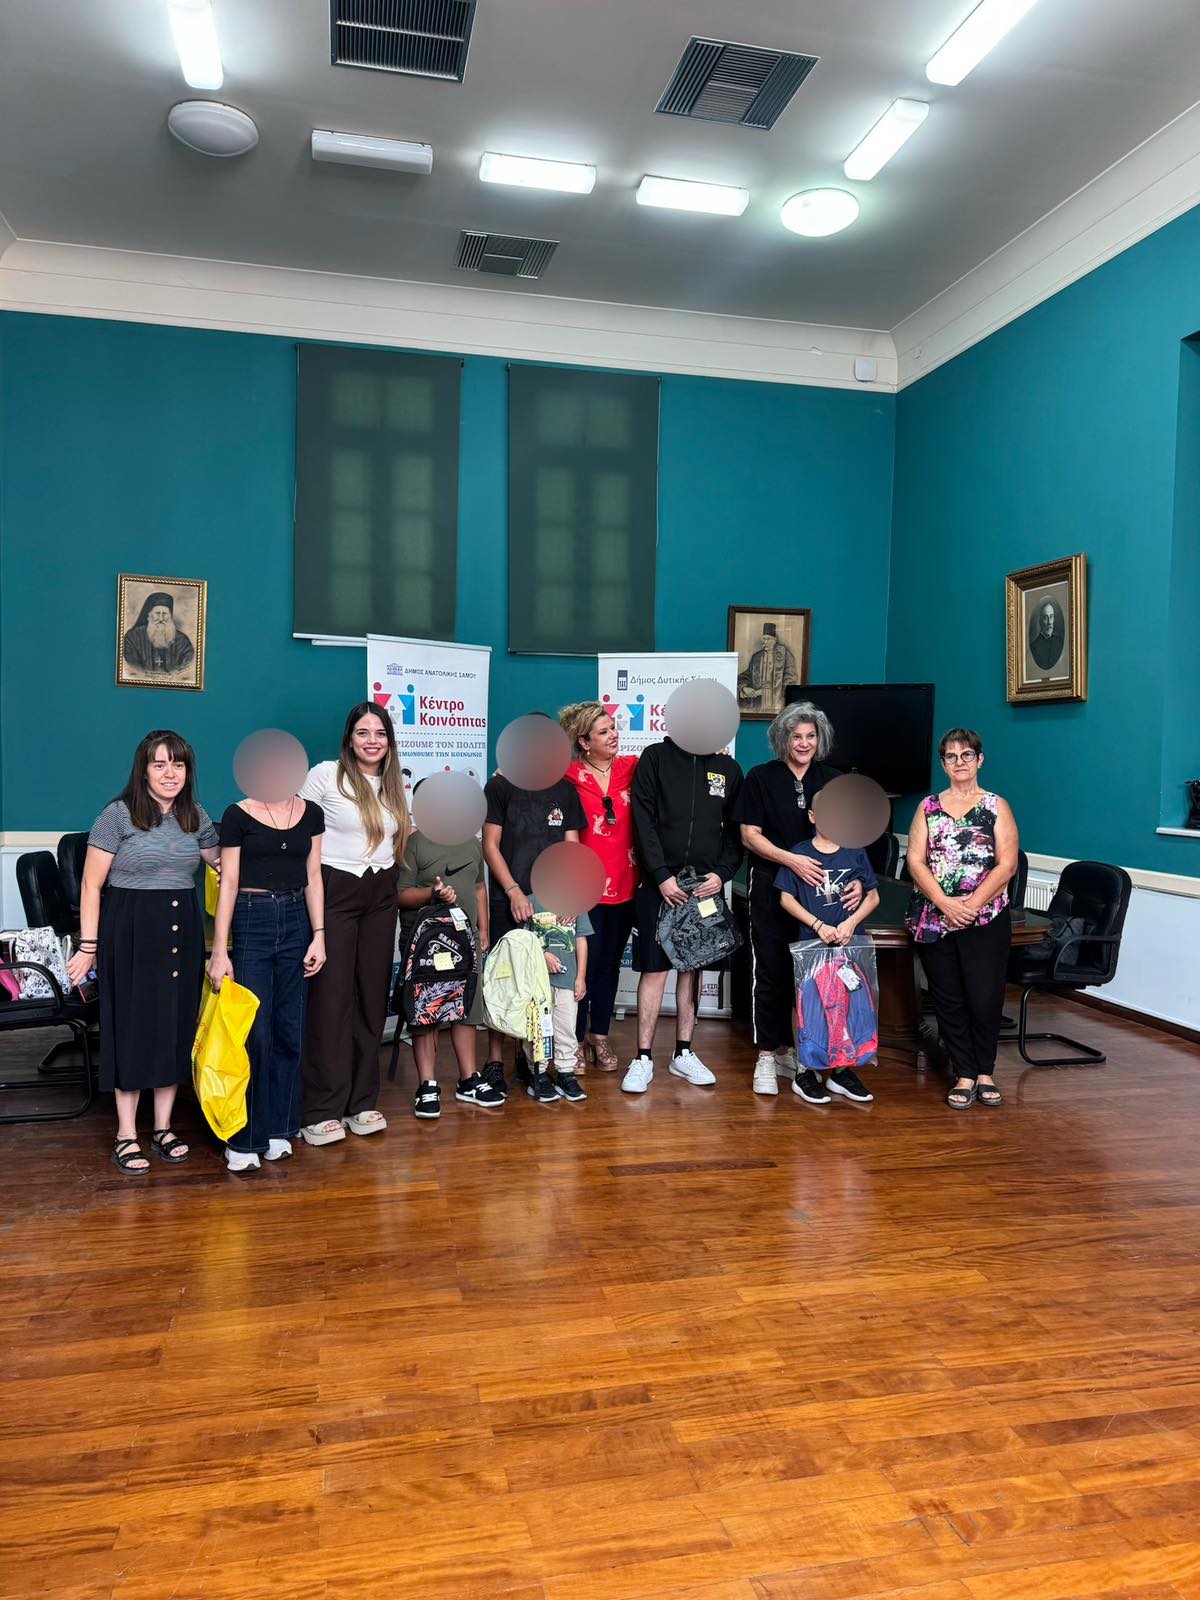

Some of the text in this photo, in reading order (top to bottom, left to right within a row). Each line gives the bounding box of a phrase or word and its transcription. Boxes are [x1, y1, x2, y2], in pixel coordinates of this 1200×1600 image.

[424, 670, 458, 678] ΑΝΑΤΟΛΙΚΗΣ
[630, 675, 656, 685] Δήμος
[657, 675, 688, 685] Δυτικής
[419, 695, 465, 713] Κέντρο
[419, 712, 487, 728] Κοινότητας
[438, 933, 461, 950] SKATE
